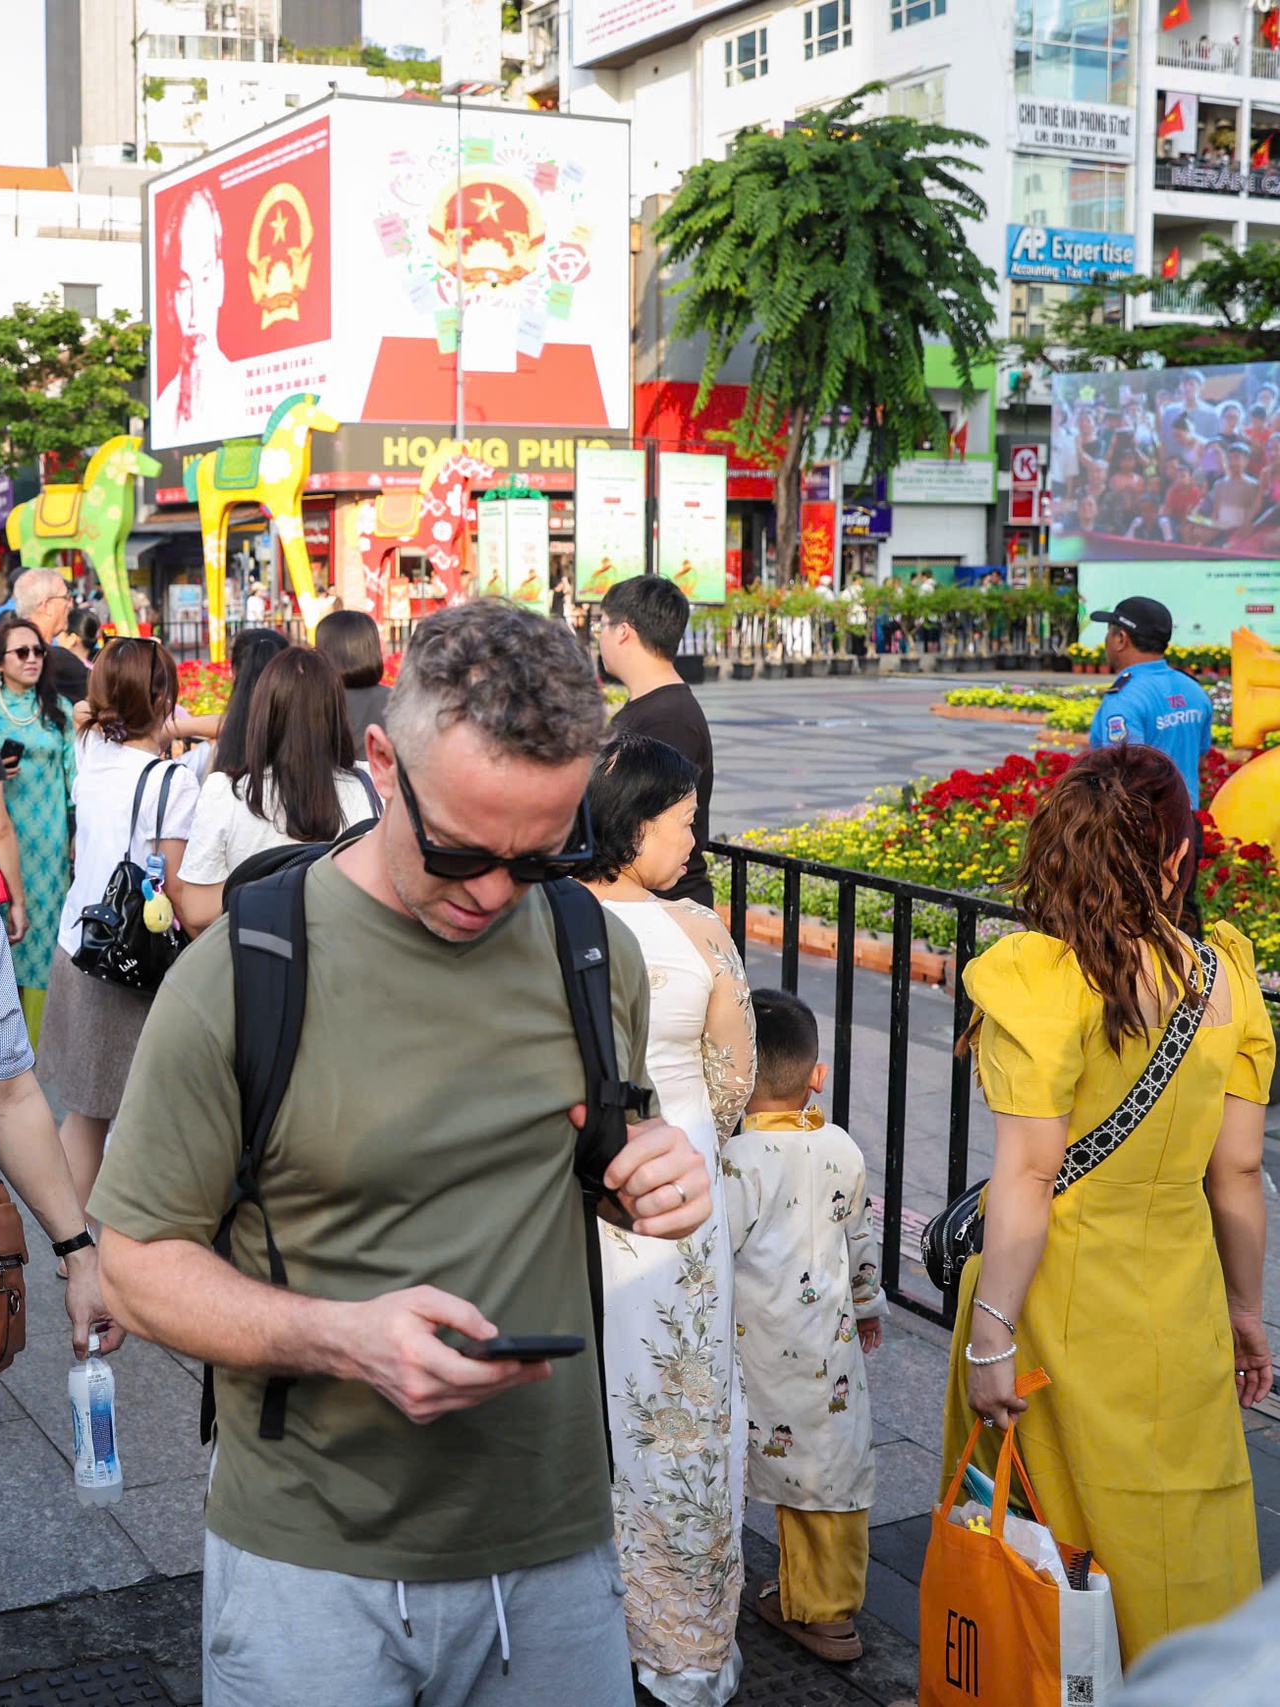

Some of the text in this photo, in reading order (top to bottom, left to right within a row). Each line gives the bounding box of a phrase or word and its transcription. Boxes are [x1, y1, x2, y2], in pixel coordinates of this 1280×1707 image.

[1019, 103, 1036, 125] CHO
[1052, 236, 1134, 266] Expertise
[1011, 261, 1060, 280] Accounting
[1020, 457, 1035, 478] K
[946, 1608, 979, 1698] EM
